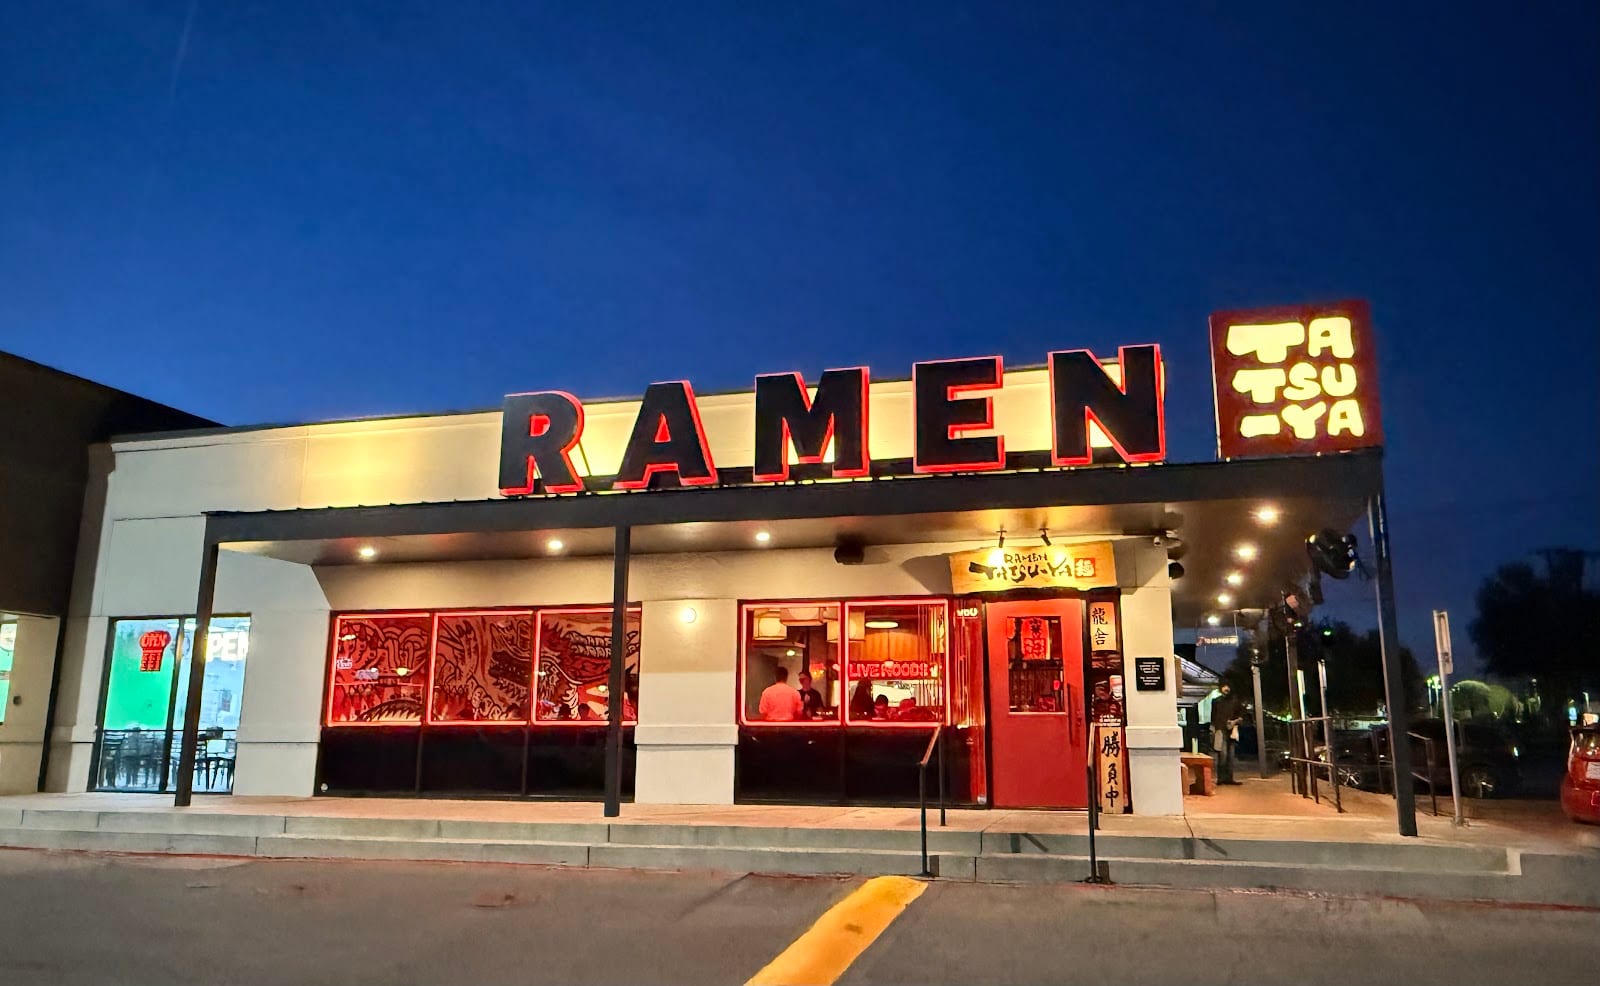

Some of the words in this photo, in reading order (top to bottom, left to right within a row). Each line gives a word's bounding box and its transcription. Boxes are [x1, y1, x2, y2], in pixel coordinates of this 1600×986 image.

[1226, 316, 1354, 363] TA
[1232, 362, 1357, 403] TSU
[499, 343, 1166, 497] RAMEN
[968, 557, 1073, 583] TATSU-YA
[1004, 552, 1048, 564] RAMEN
[205, 631, 249, 662] PEN
[849, 663, 880, 677] LIVE
